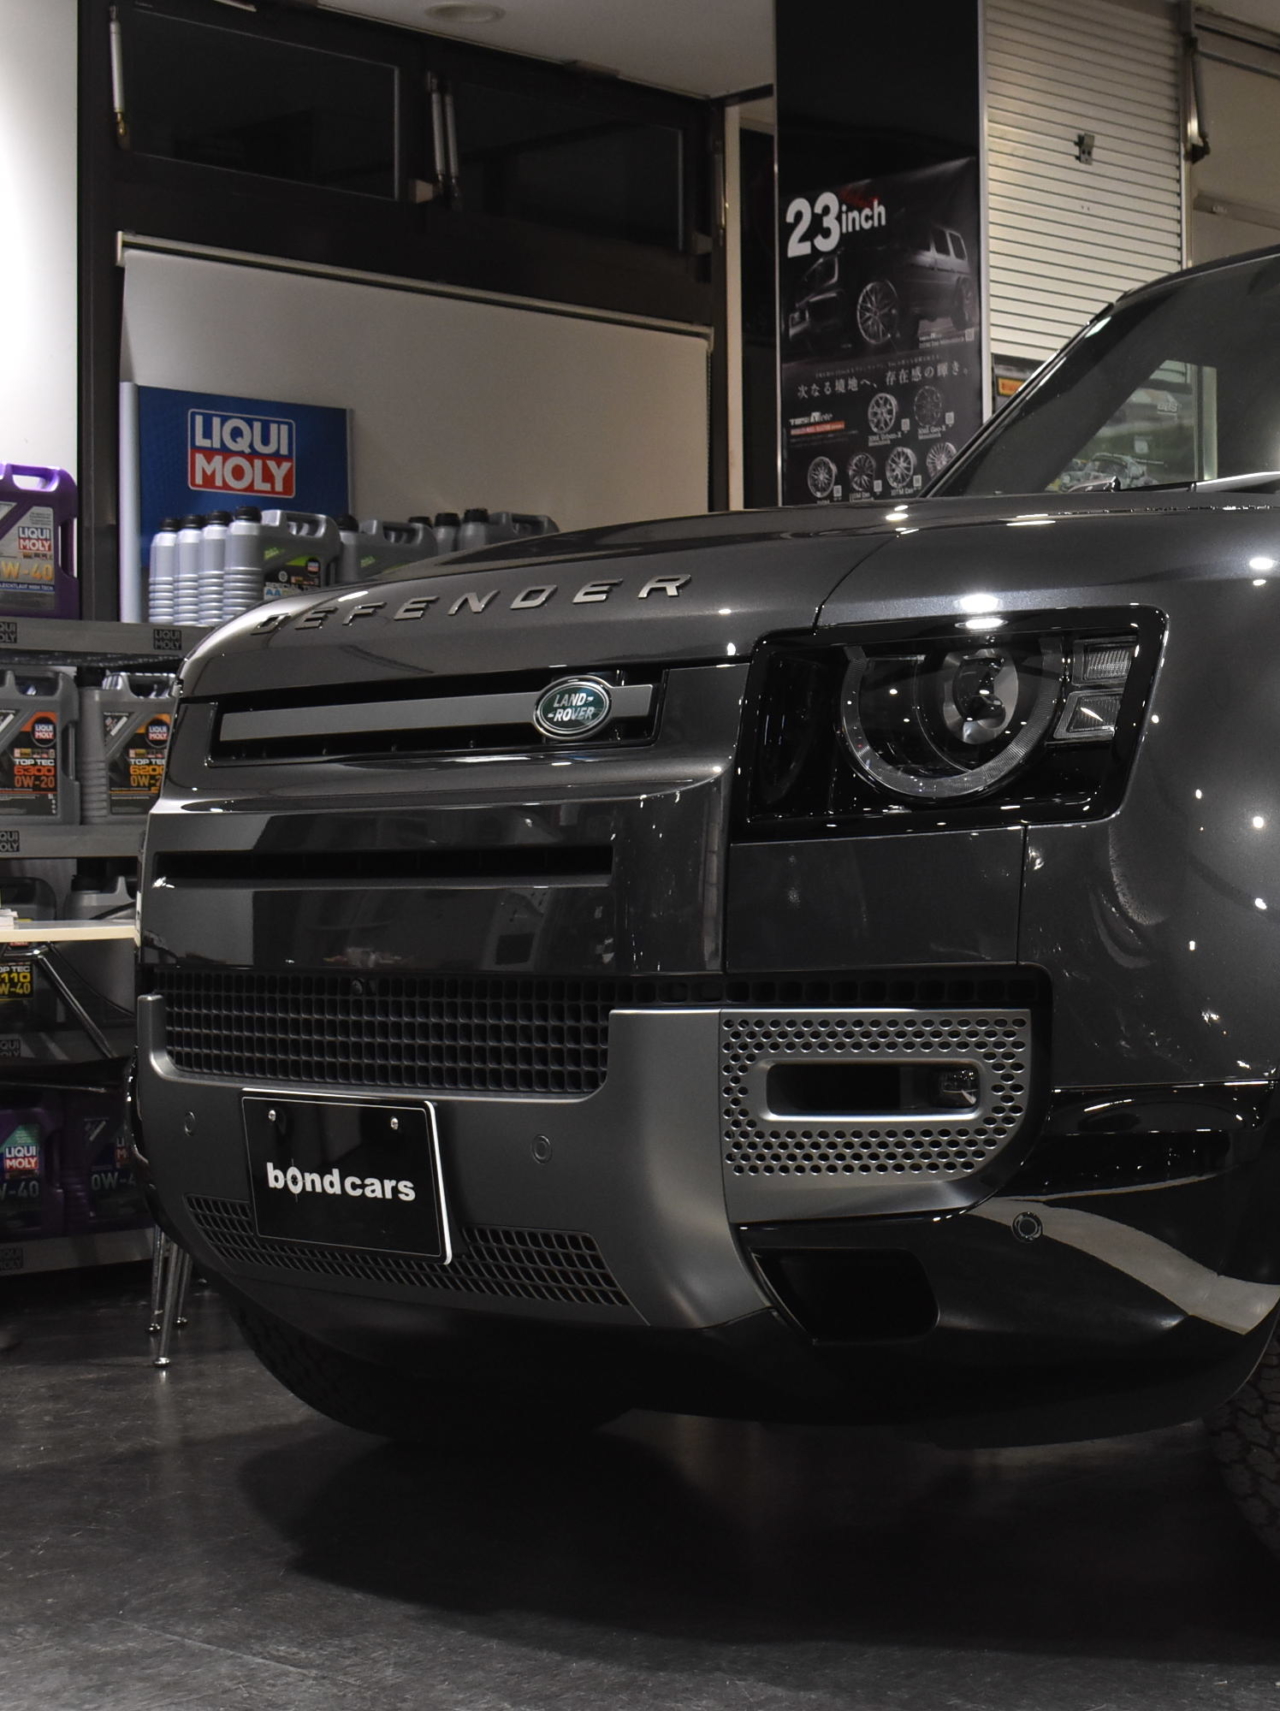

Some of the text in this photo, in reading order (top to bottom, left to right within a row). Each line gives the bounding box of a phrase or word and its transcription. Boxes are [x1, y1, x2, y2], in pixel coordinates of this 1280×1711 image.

[195, 414, 289, 455] LIQUI
[195, 453, 292, 492] MOLY
[19, 527, 50, 539] LIQUI
[20, 539, 51, 551] MOLY
[0, 561, 53, 580] W-40
[251, 574, 692, 636] DEFENDER
[0, 623, 16, 632] QUI
[0, 633, 17, 643] OLY
[154, 630, 180, 639] LIQUI
[154, 639, 181, 649] MOLY
[35, 724, 53, 732] LIQUI
[14, 766, 55, 776] 6300
[130, 775, 162, 787] 0W-2
[0, 832, 18, 841] QUI
[0, 842, 19, 851] OLY
[0, 972, 31, 982] 110
[0, 983, 31, 994] W-40
[0, 1040, 19, 1050] QUI
[5, 1146, 36, 1158] LIQUI
[6, 1158, 38, 1169] MOLY
[91, 1172, 136, 1190] 0W-4
[0, 1181, 39, 1199] -40
